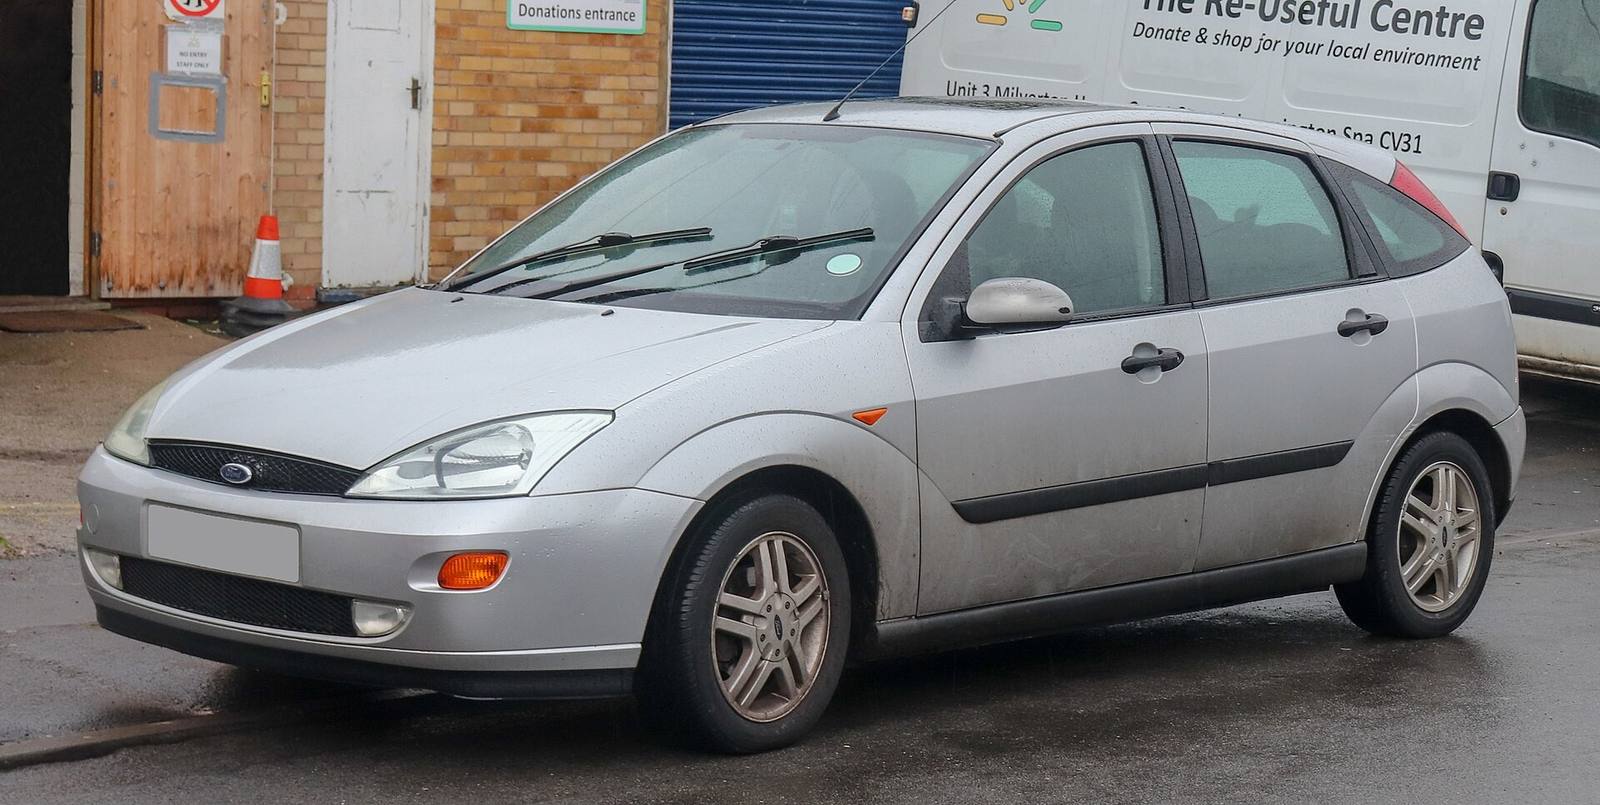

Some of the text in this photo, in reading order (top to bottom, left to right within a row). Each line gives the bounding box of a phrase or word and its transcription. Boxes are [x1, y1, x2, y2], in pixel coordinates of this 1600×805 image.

[519, 4, 636, 21] Donations entrance
[1370, 0, 1485, 40] Centre
[1133, 22, 1191, 42] Donate
[1195, 27, 1208, 44] &
[1212, 29, 1252, 51] shop
[1283, 40, 1324, 56] your
[1327, 40, 1370, 60] local
[1373, 47, 1481, 71] environment
[946, 80, 977, 97] Unit
[983, 84, 990, 97] 3
[1380, 131, 1422, 154] CV31
